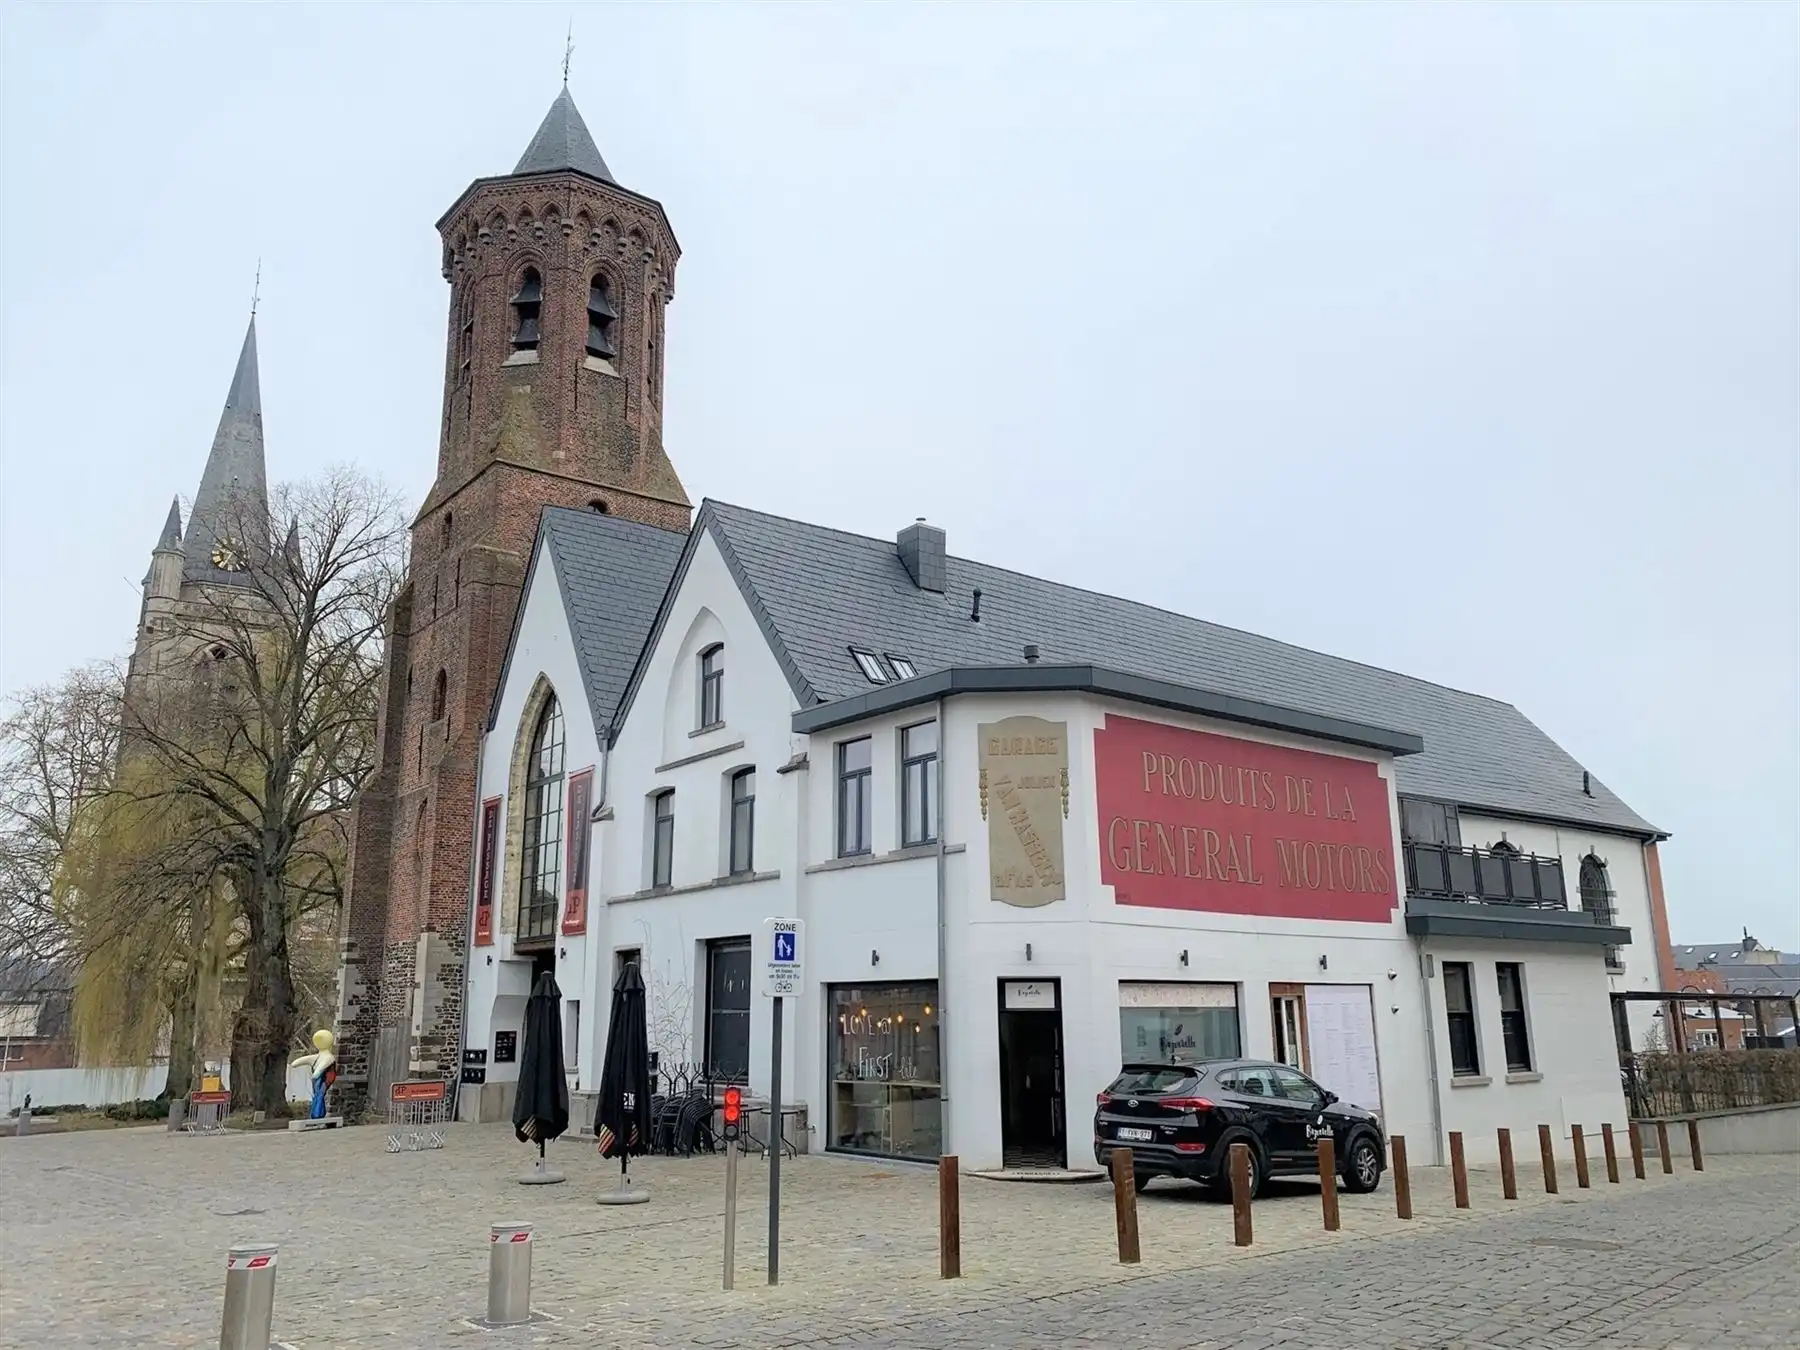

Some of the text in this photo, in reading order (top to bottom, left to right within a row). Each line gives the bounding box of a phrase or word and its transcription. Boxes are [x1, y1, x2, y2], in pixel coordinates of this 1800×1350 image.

[988, 737, 1059, 755] GARAGE
[1143, 751, 1358, 823] PRODUITS DE LA
[1108, 816, 1392, 895] GENERAL MOTORS
[774, 923, 796, 932] ZONE
[843, 1014, 875, 1036] LOVE
